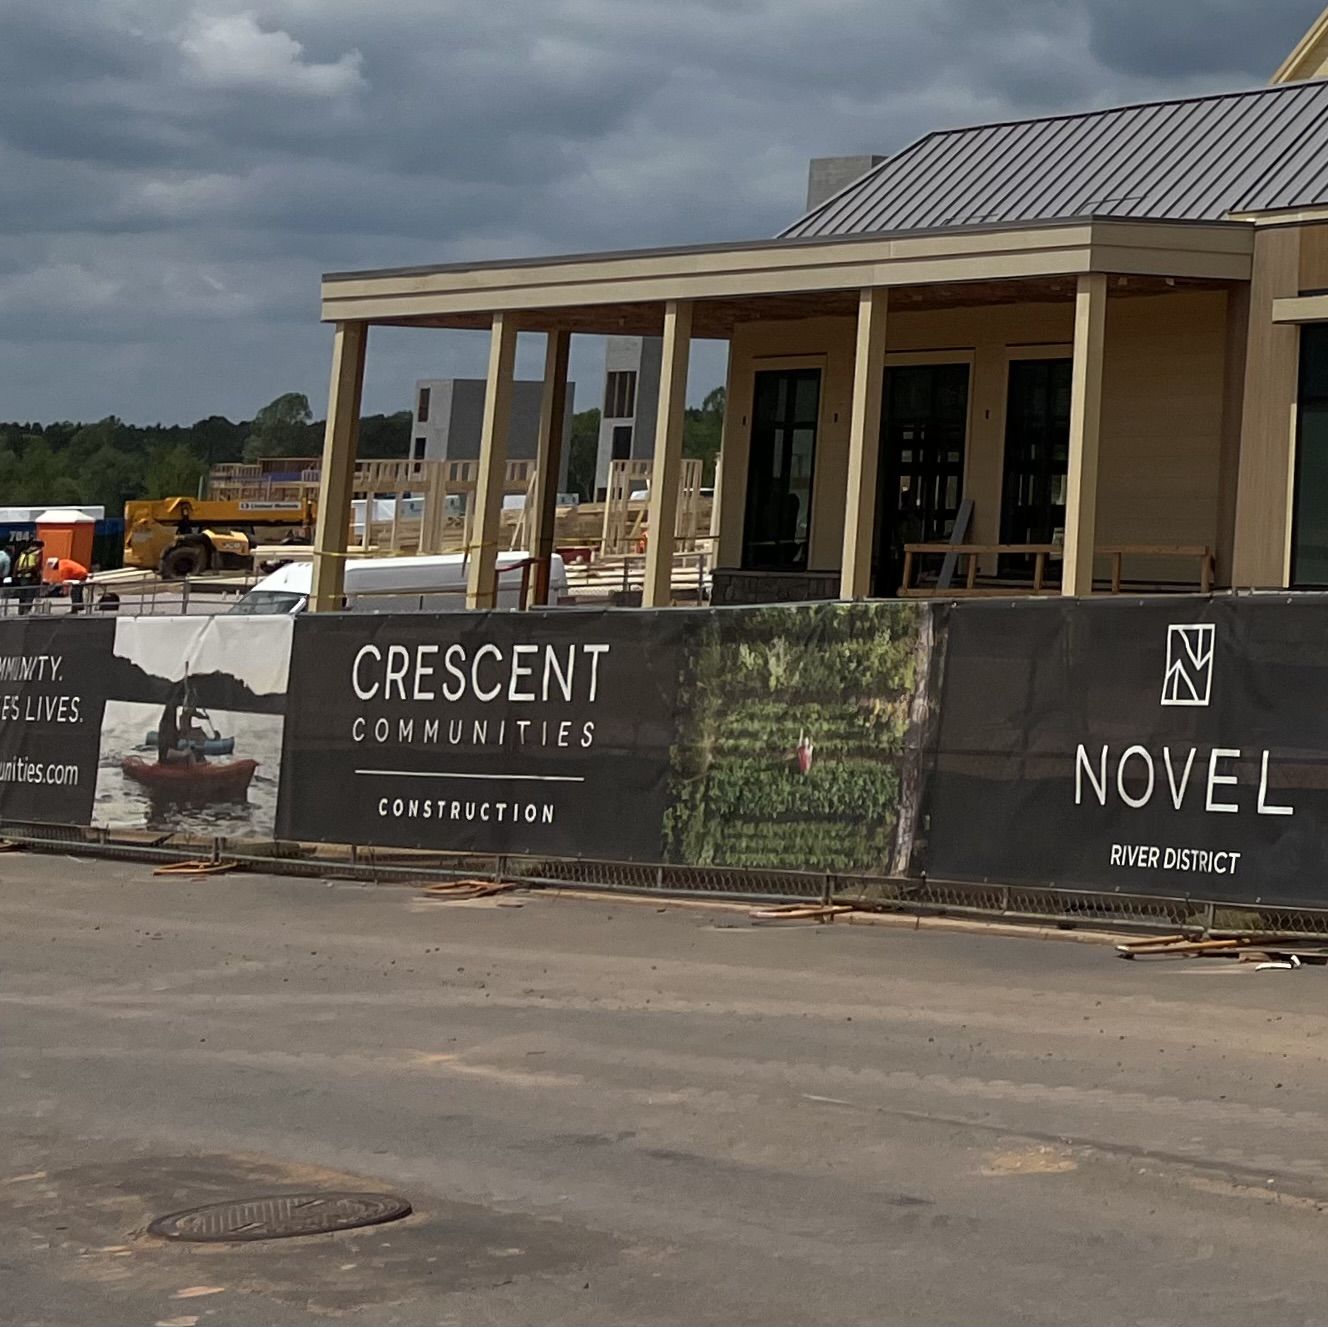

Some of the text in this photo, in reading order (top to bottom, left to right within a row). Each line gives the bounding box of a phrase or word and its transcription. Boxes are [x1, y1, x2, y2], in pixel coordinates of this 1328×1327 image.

[352, 643, 611, 702] CRESCENT
[25, 696, 83, 723] LIVES.
[352, 717, 596, 748] COMMUNITIES
[1075, 743, 1295, 815] NOVEL
[378, 797, 555, 824] CONSTRUCTION
[1110, 844, 1241, 875] RIVER DISTRICT
